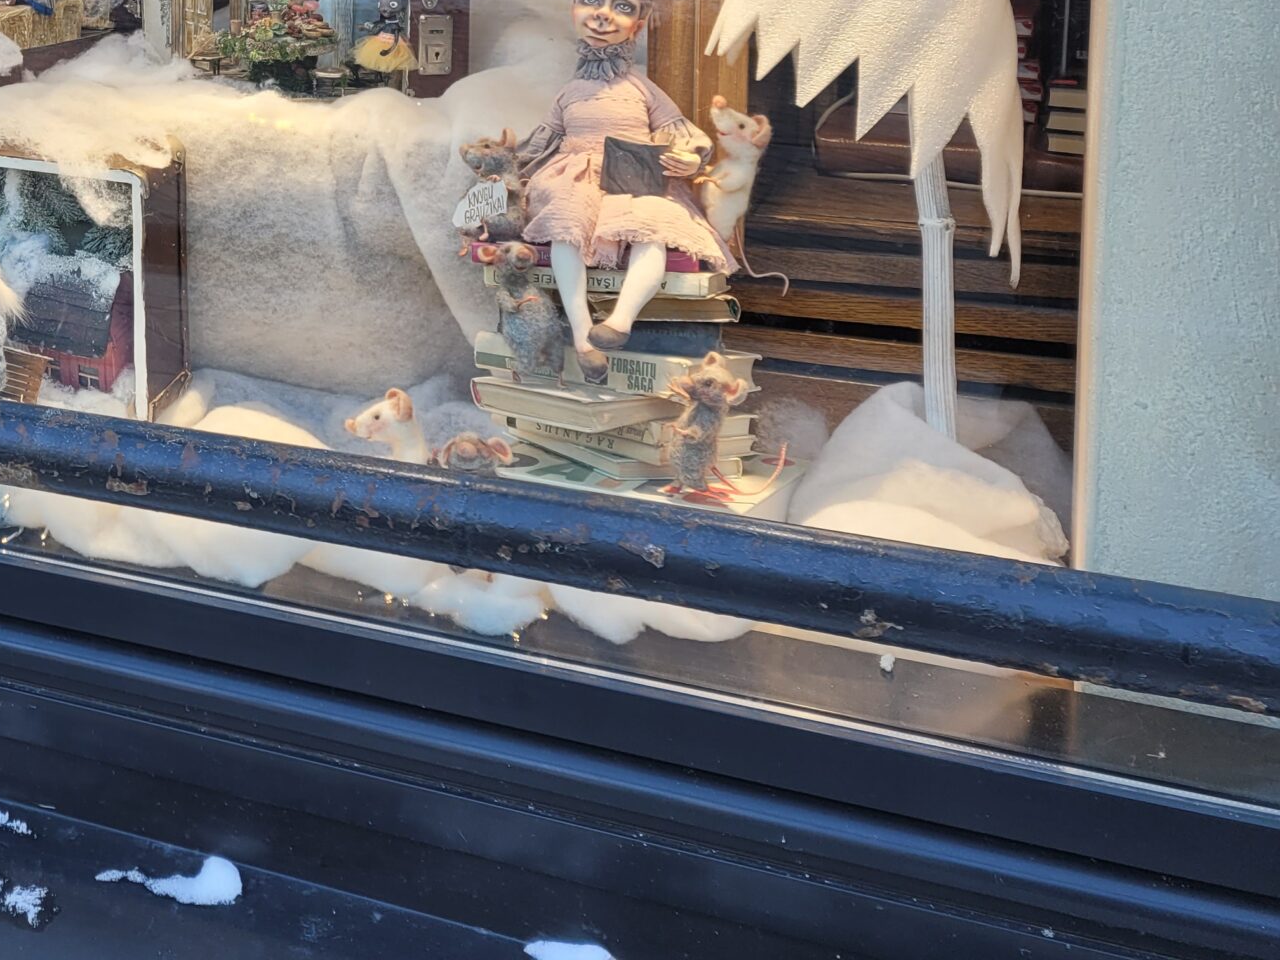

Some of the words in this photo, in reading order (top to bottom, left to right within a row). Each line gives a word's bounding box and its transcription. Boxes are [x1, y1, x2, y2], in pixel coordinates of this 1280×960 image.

[611, 357, 657, 379] FORSAITŲ
[627, 375, 654, 393] SAGA
[535, 422, 614, 449] RAGANIUS
